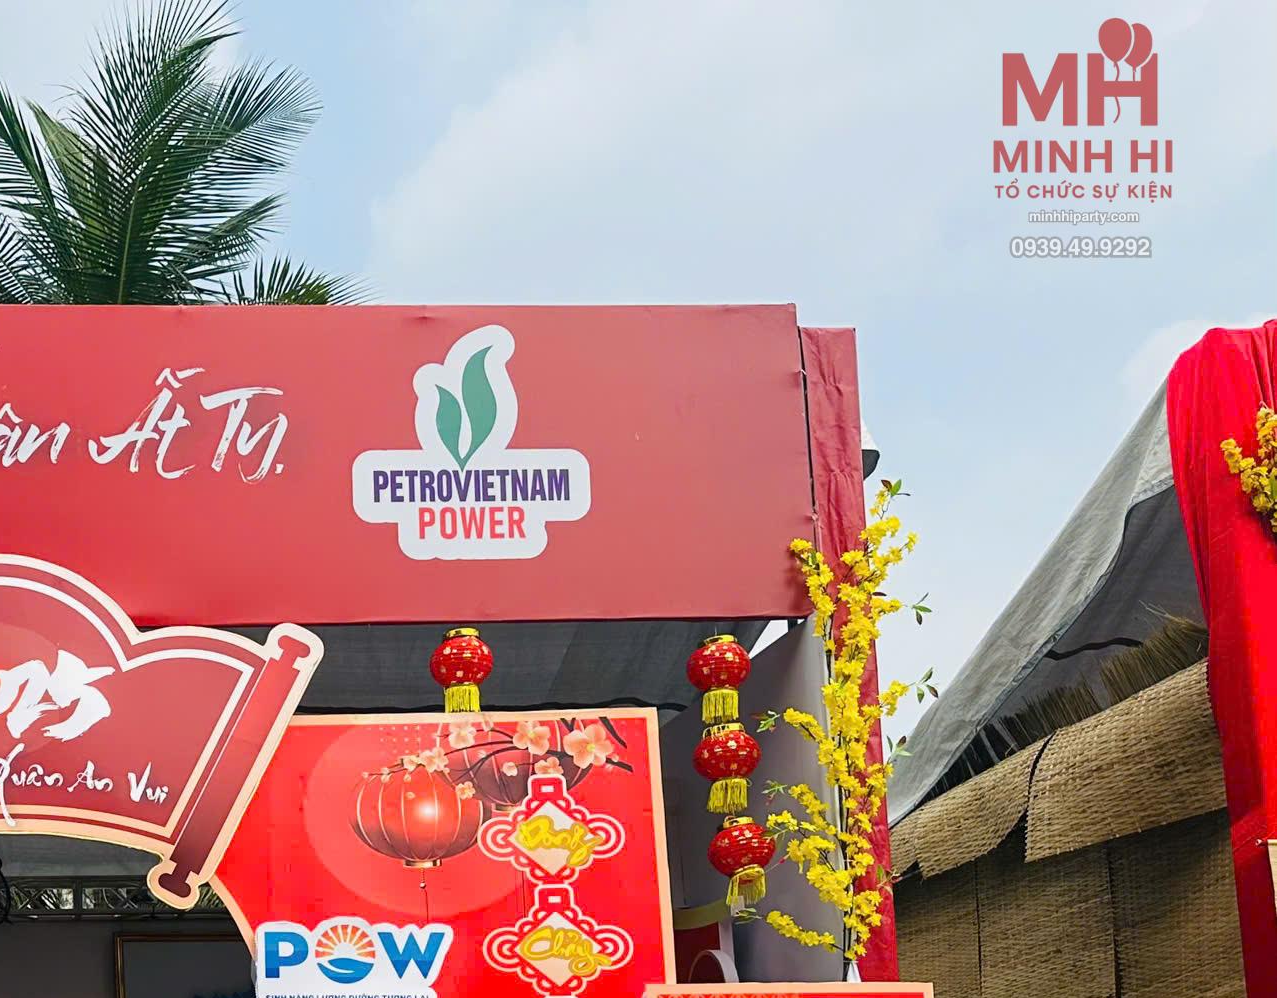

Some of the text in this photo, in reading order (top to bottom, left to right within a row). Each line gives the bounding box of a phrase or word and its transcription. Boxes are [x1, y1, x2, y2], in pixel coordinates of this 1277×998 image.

[372, 468, 570, 503] PETROVIETNAM
[418, 506, 526, 540] POWER
[67, 760, 114, 792] An
[128, 762, 169, 805] Vui
